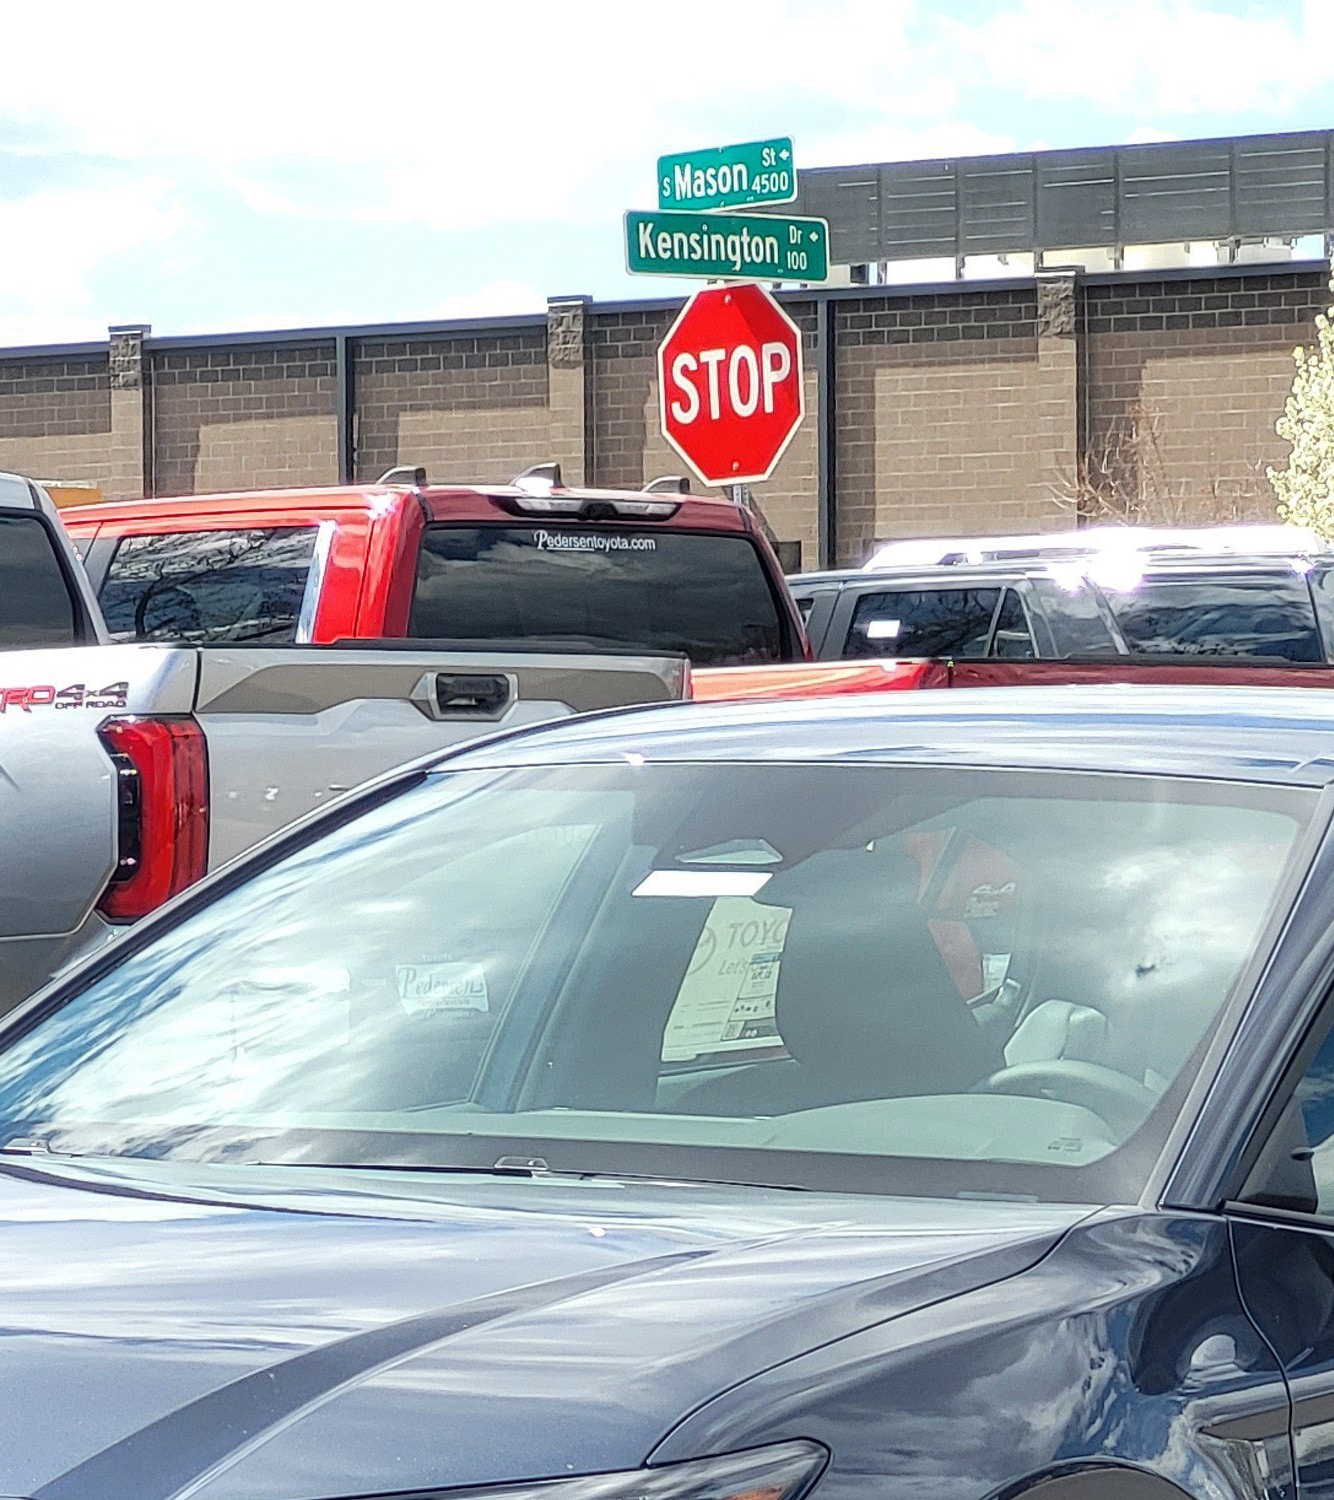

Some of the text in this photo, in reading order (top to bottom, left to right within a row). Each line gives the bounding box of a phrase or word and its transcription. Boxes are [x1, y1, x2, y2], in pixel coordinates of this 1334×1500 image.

[662, 147, 777, 201] S Mason St
[751, 171, 789, 194] 4500
[638, 222, 802, 272] Kensington Dr
[786, 251, 808, 271] 100
[671, 341, 791, 425] STOP
[534, 530, 656, 552] Pedersentoyota.com
[57, 682, 129, 700] 4x4
[86, 700, 127, 709] ROAD
